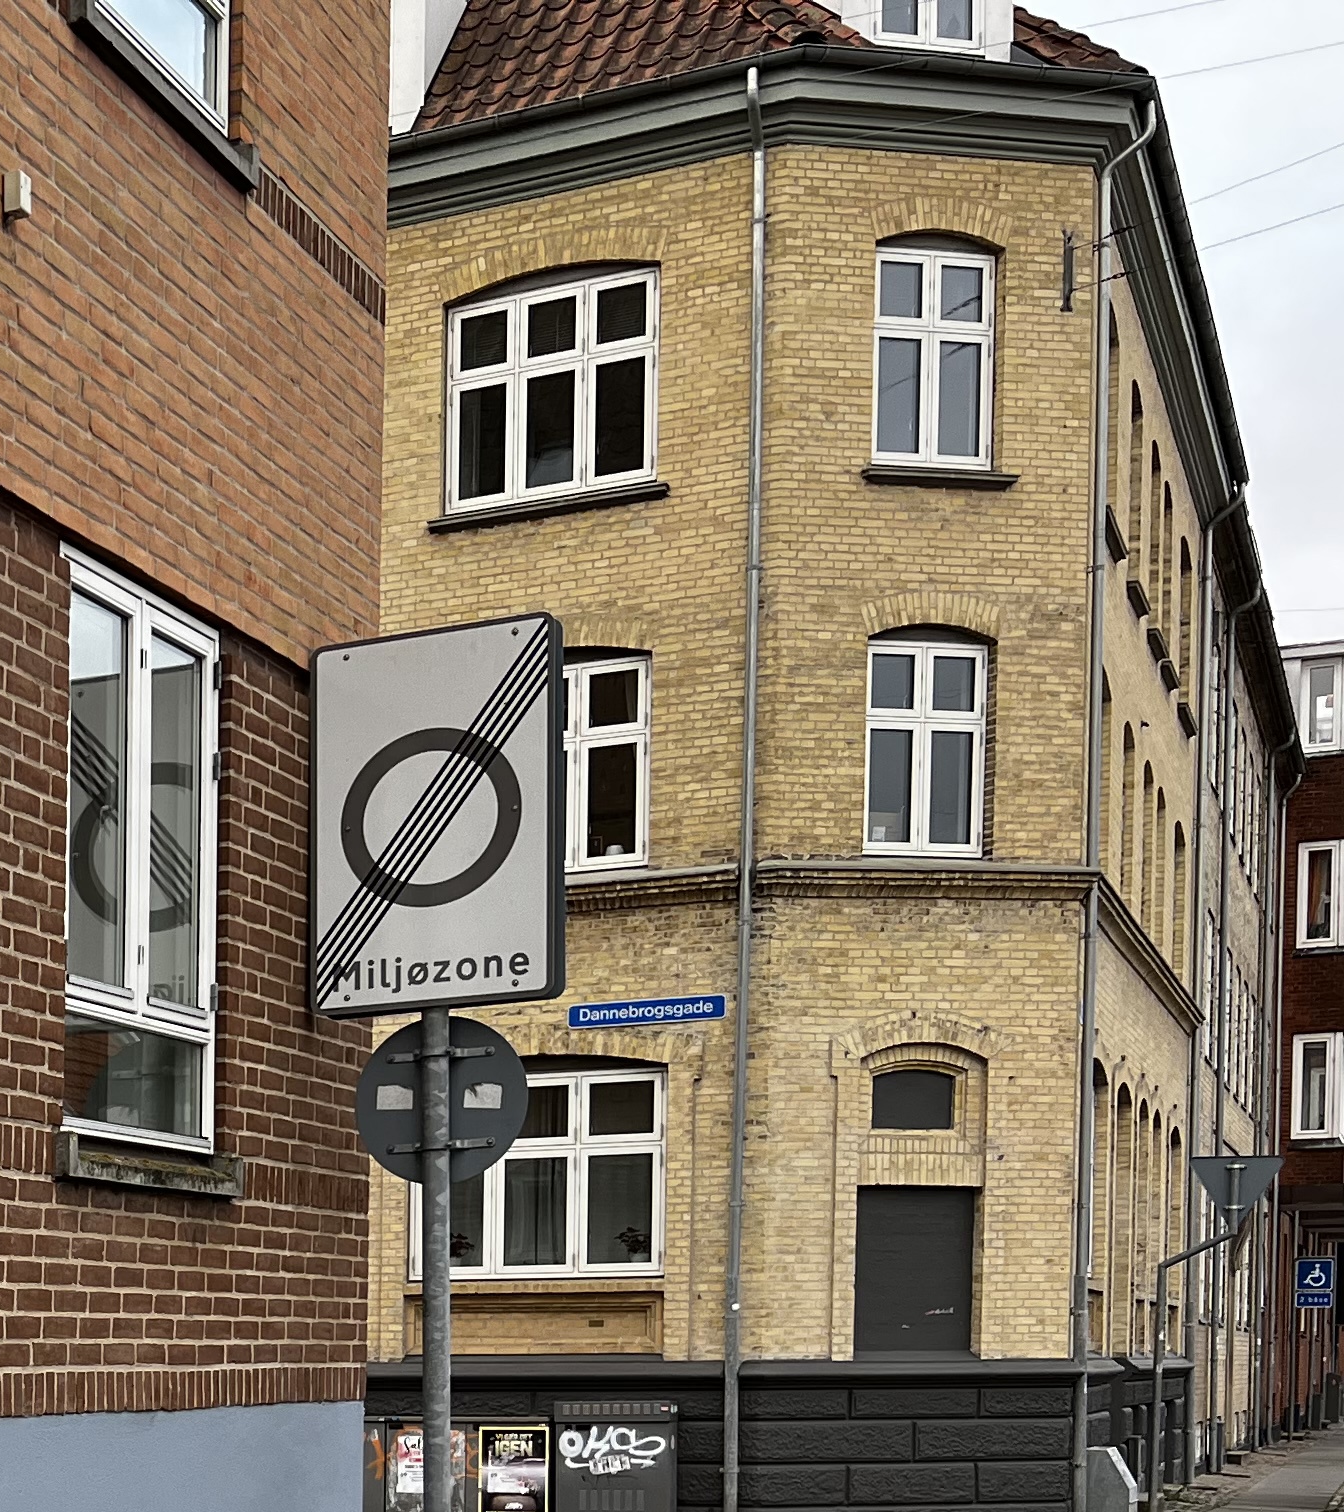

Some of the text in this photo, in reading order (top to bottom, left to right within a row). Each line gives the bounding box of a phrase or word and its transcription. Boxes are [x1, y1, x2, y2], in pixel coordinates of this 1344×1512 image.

[333, 951, 530, 994] Miljøzone
[578, 1000, 714, 1022] Dannebrogsgade
[494, 1440, 534, 1457] IGEN
